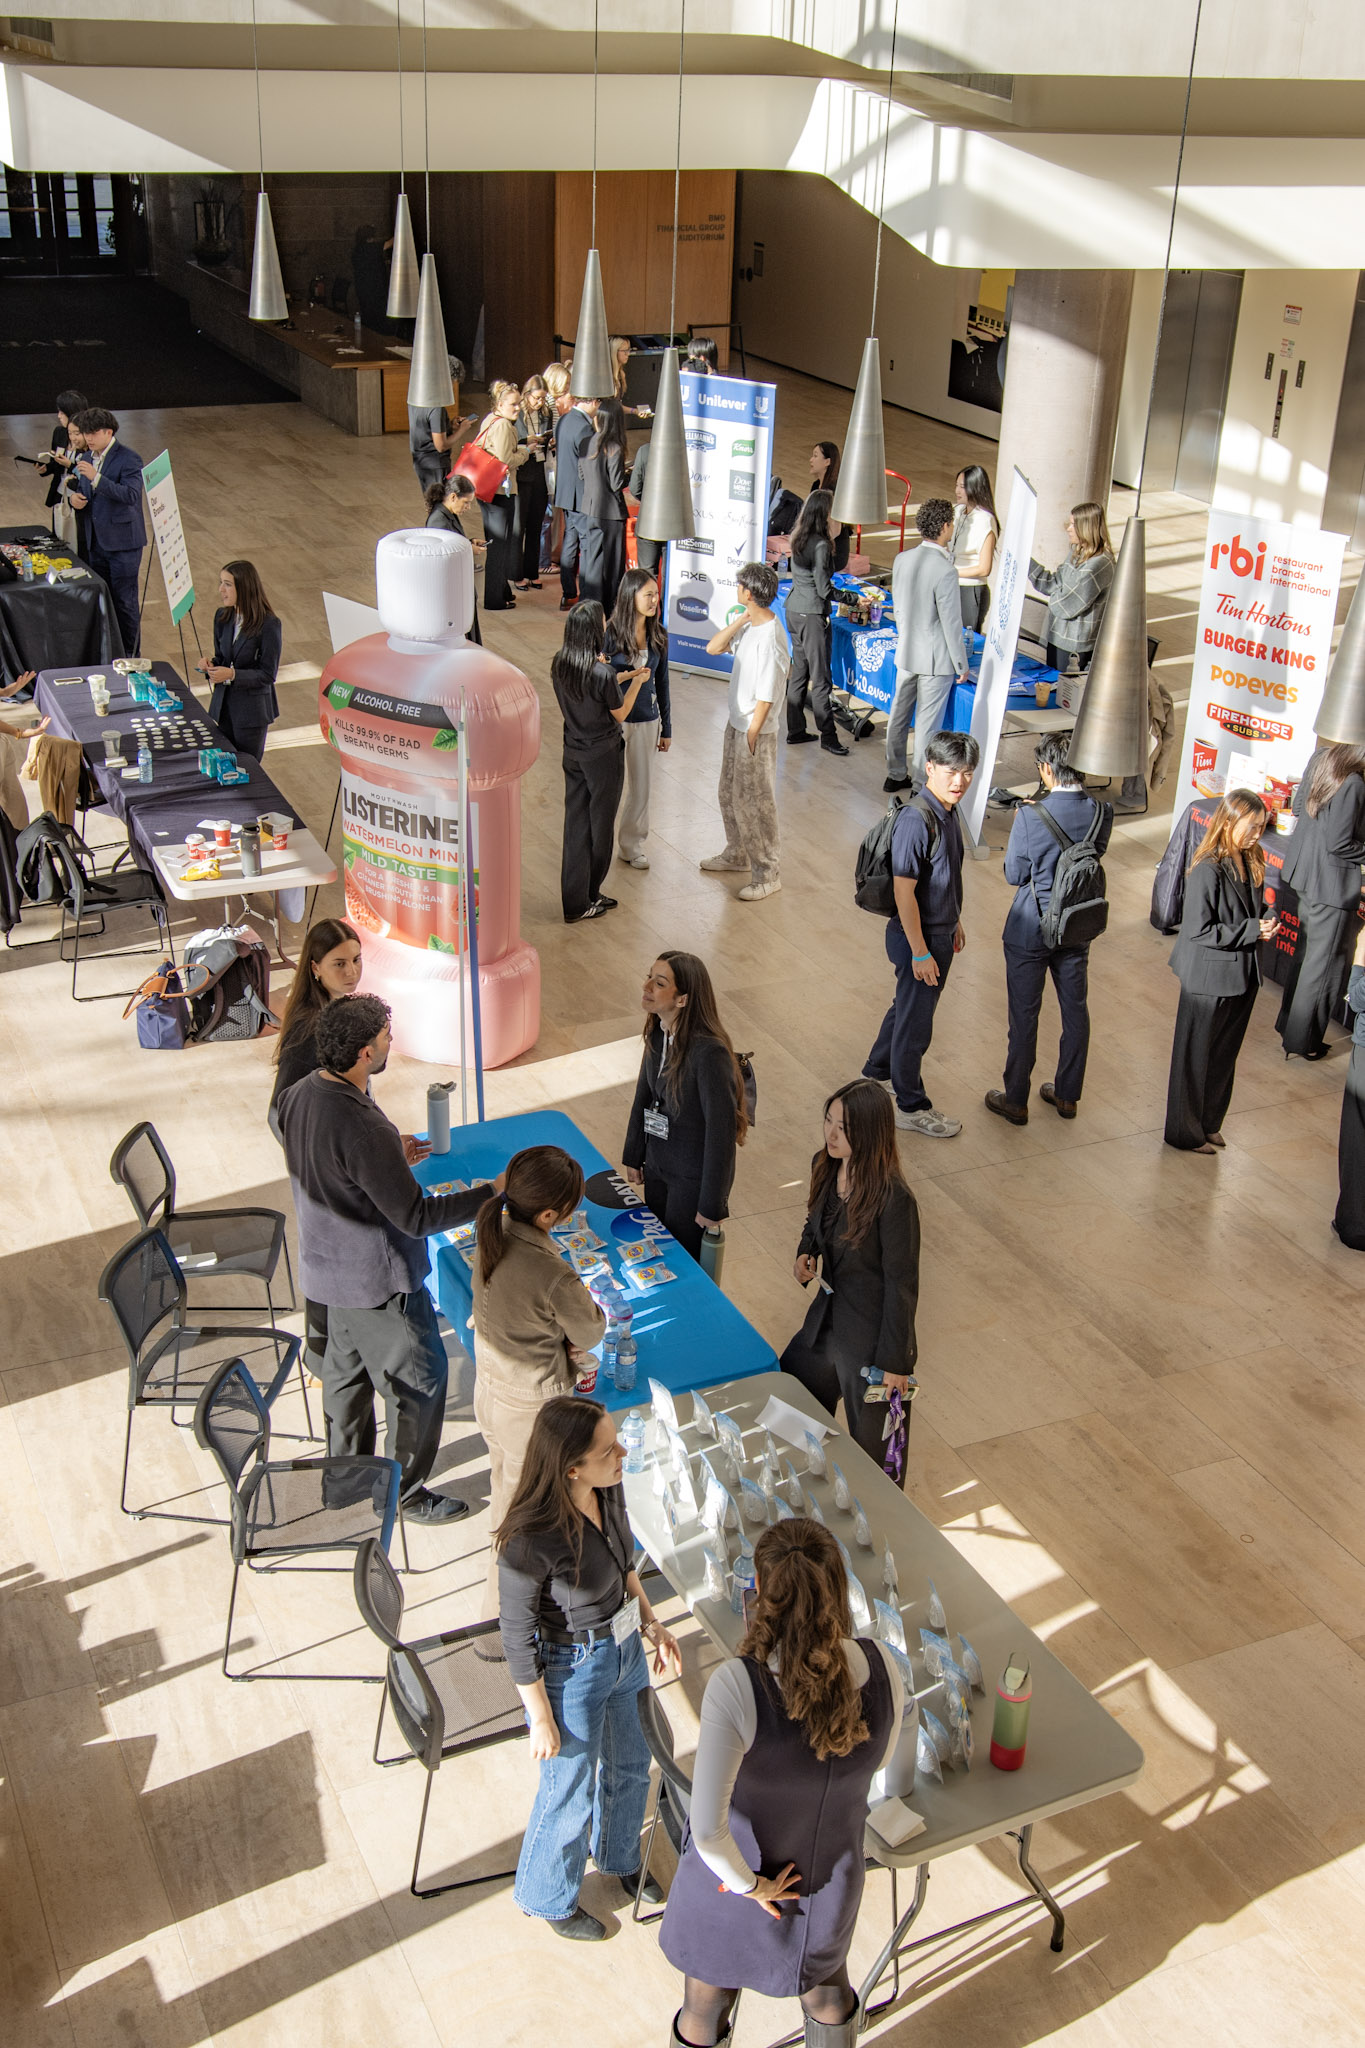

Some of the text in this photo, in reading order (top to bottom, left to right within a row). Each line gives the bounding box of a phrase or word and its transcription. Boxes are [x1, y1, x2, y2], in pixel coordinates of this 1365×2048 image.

[678, 233, 726, 241] AUDITORIUM
[699, 224, 726, 232] GROUP
[698, 392, 748, 411] Unilever
[685, 432, 714, 446] ELLMANN'S
[1210, 534, 1268, 582] rbi
[1273, 555, 1324, 573] restaurant
[680, 570, 707, 582] AXE
[1272, 565, 1306, 580] brands
[1270, 575, 1332, 598] international
[678, 602, 708, 615] Vaseline
[1216, 593, 1312, 636] Tim Hortons
[1204, 627, 1316, 672] BURGER KING
[846, 668, 890, 704] Unilever
[330, 684, 422, 718] NEW ALCOHOL FREE
[335, 718, 421, 750] KILLS 99.9% OF BAD
[1209, 705, 1290, 739] FIREHOUSE
[1232, 724, 1260, 738] SUBS
[344, 734, 410, 760] BREATH GERMS
[1194, 752, 1212, 768] Tim
[370, 792, 418, 810] MOUTHWASH
[344, 786, 459, 844] LISTERINE
[344, 819, 464, 864] WATERMELON MIN
[361, 848, 437, 881] MILD TASTE
[357, 872, 444, 904] CLEANER MOUTH THAN
[364, 866, 377, 878] FOR
[378, 873, 384, 881] A
[422, 885, 430, 893] &
[364, 884, 432, 912] BRUSHING ALONE
